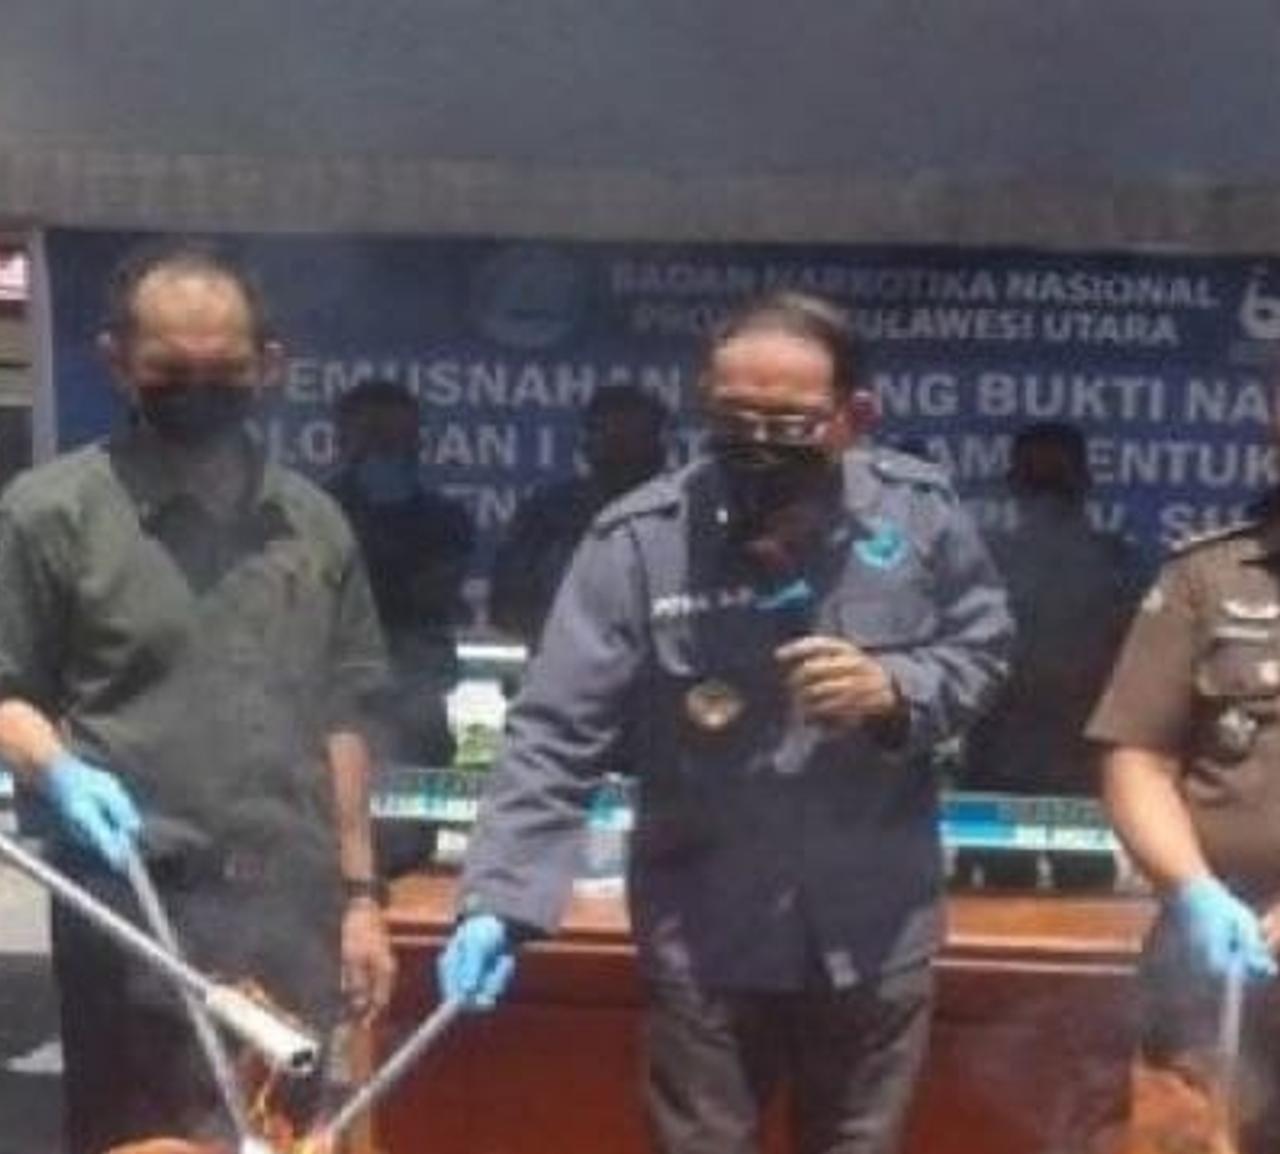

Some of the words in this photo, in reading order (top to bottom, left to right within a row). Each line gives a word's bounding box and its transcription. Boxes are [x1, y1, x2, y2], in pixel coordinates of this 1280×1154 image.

[1005, 270, 1218, 308] NASIONAL
[1042, 311, 1180, 346] UTARA
[977, 371, 1167, 424] BUKTI
